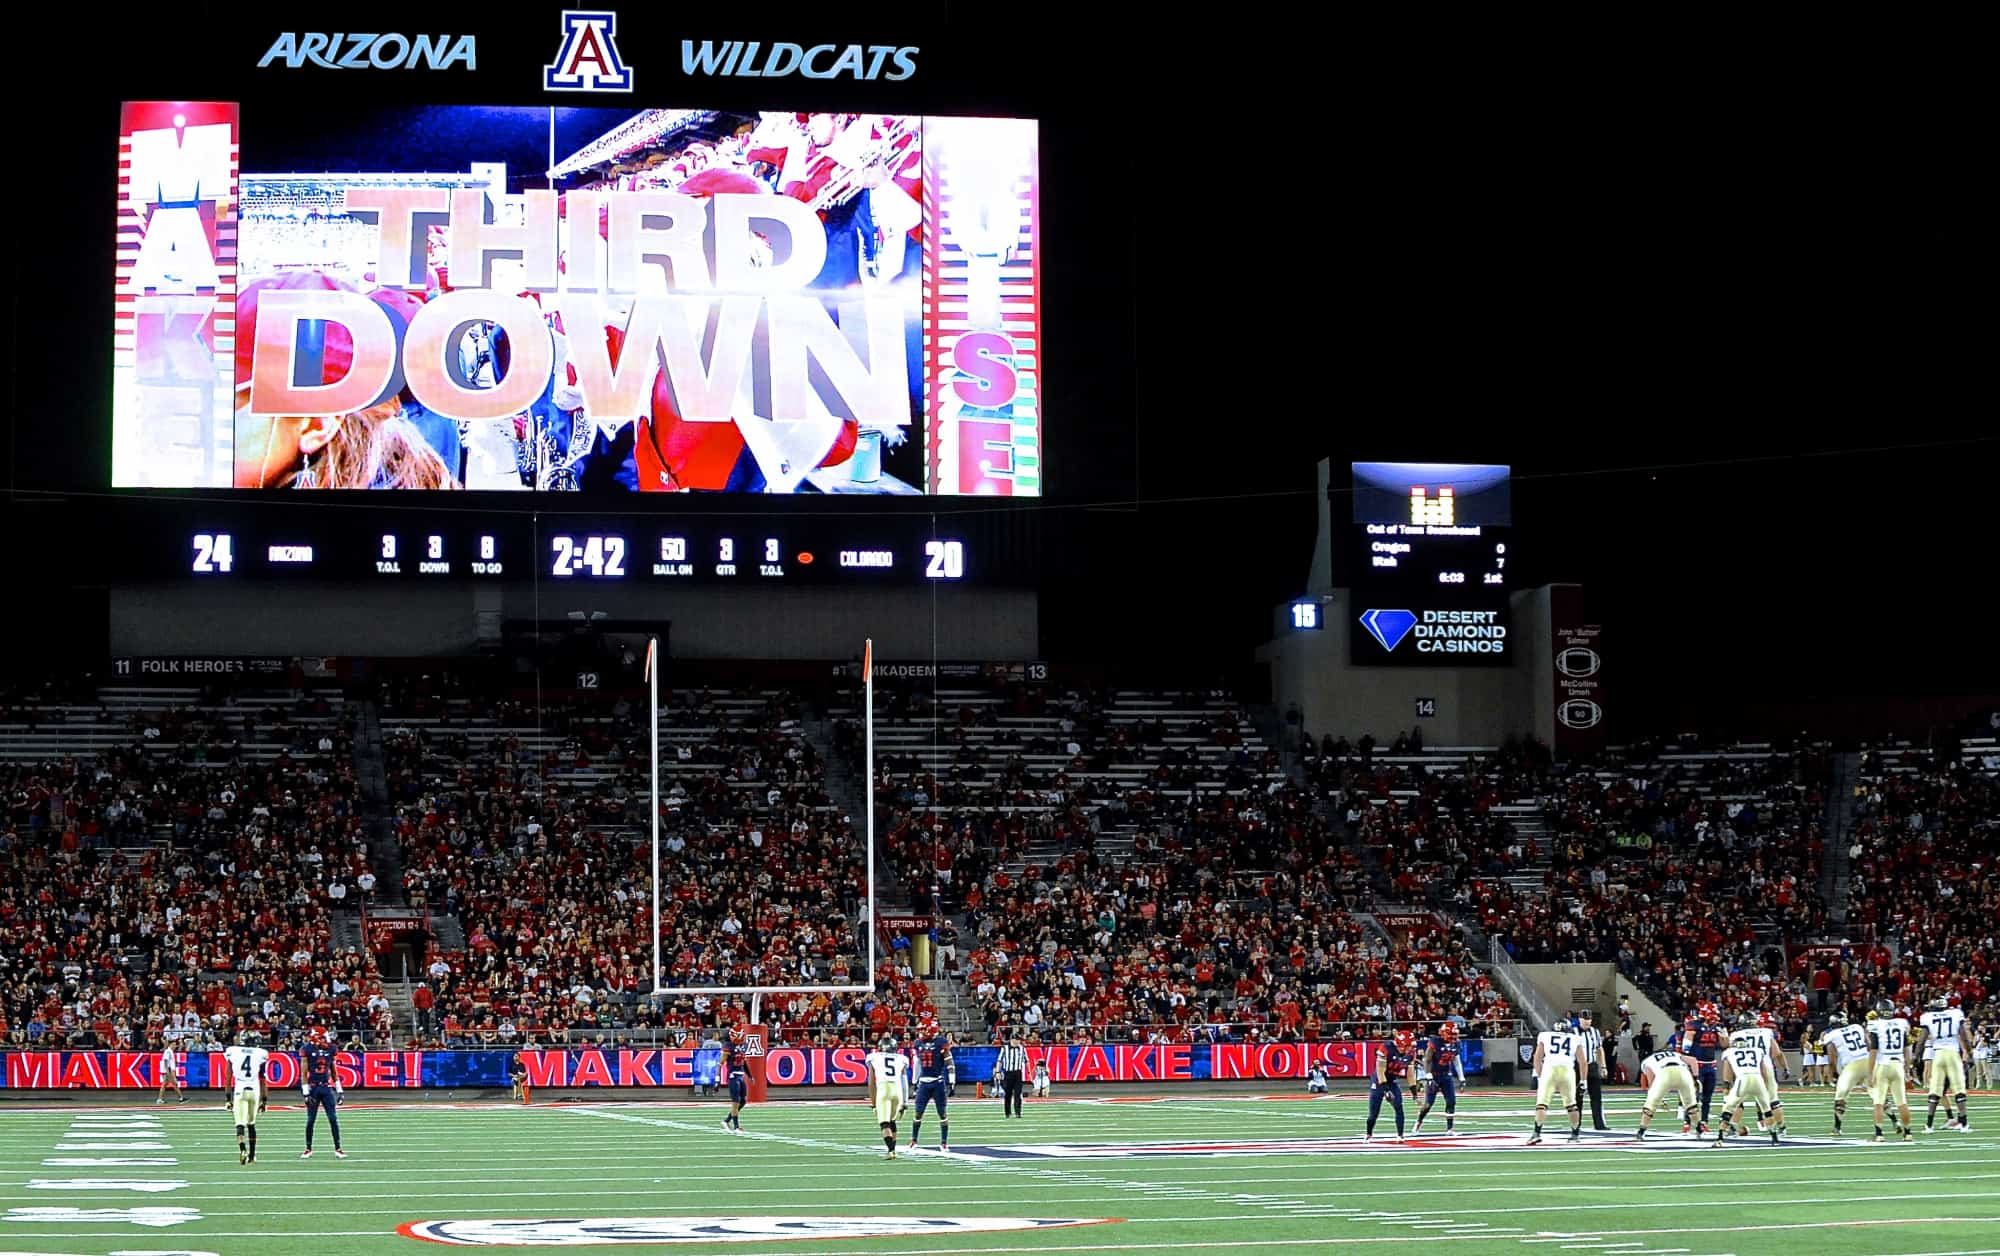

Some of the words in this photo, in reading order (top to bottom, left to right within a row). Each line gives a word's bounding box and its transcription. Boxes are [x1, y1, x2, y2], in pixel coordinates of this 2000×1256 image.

[257, 32, 476, 70] ARIZONA
[543, 10, 633, 92] A
[681, 39, 920, 81] WILDCATS
[343, 188, 828, 291] THIRD
[250, 288, 911, 425] DOWN
[193, 535, 232, 571] 24
[382, 535, 396, 558] 3
[428, 535, 442, 558] 3
[553, 537, 624, 575] 2:42
[661, 538, 685, 560] 50
[720, 538, 733, 561] 3
[765, 539, 778, 561] 3
[1372, 542, 1410, 554] Oregon
[419, 561, 450, 573] DOWN
[471, 562, 486, 574] TO
[487, 562, 502, 574] GO
[925, 541, 963, 577] 20
[1496, 559, 1504, 568] 7
[653, 564, 677, 575] BALL
[678, 564, 693, 575] ON
[716, 564, 736, 576] QTR
[1292, 604, 1315, 627] 15
[1423, 611, 1497, 624] DESERT
[1414, 625, 1506, 638] DIAMOND
[1416, 639, 1504, 653] CASINOS
[115, 660, 130, 674] 11
[142, 660, 179, 672] FOLK
[832, 665, 937, 677] #TMKADEEM
[1028, 665, 1046, 679] 13
[579, 673, 597, 687] 12
[1416, 700, 1434, 714] 14
[890, 920, 914, 928] SECTION
[1886, 1028, 1901, 1049] 13
[1932, 1018, 1954, 1039] 77
[1550, 1036, 1571, 1056] 54
[1843, 1031, 1867, 1051] 52
[240, 1055, 252, 1077] 4
[518, 1050, 694, 1086] MAKE
[884, 1057, 896, 1076] 5
[1022, 1045, 1191, 1080] MAKE
[1734, 1050, 1758, 1067] 23
[6, 1052, 187, 1088] MAKE
[208, 1052, 422, 1088] NOSE!
